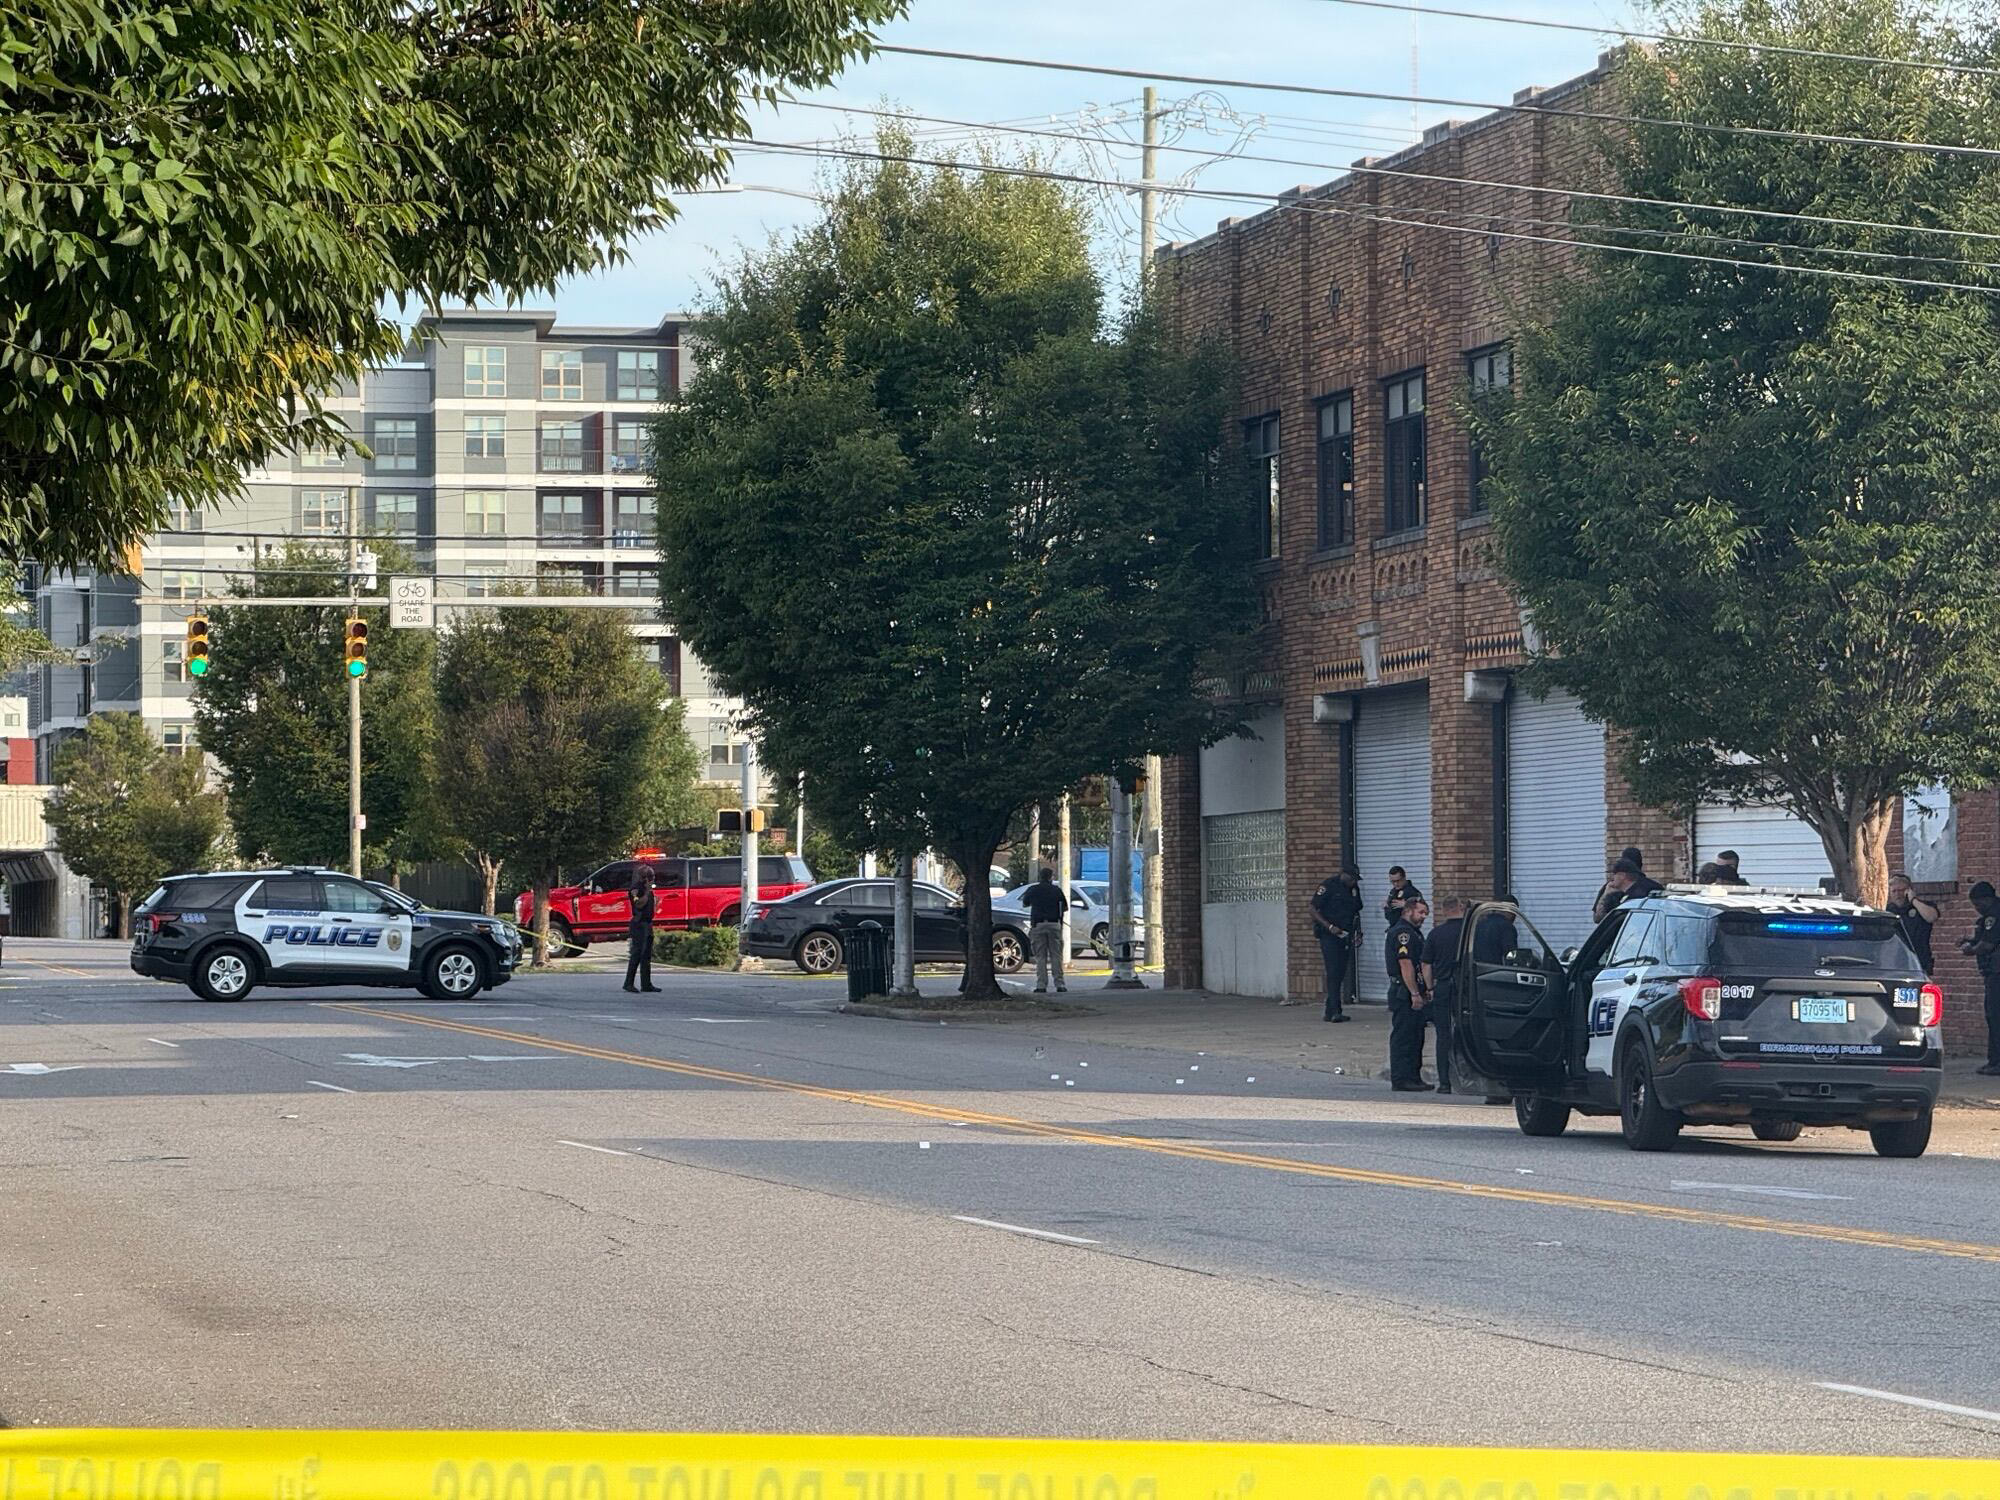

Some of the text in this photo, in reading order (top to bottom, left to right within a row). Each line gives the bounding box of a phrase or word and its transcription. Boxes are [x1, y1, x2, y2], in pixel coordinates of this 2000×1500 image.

[262, 925, 384, 947] POLICE
[1721, 985, 1755, 998] 2017
[1802, 1004, 1844, 1016] 37095 MU
[1760, 1043, 1882, 1054] BIRMINGHAM POLICE
